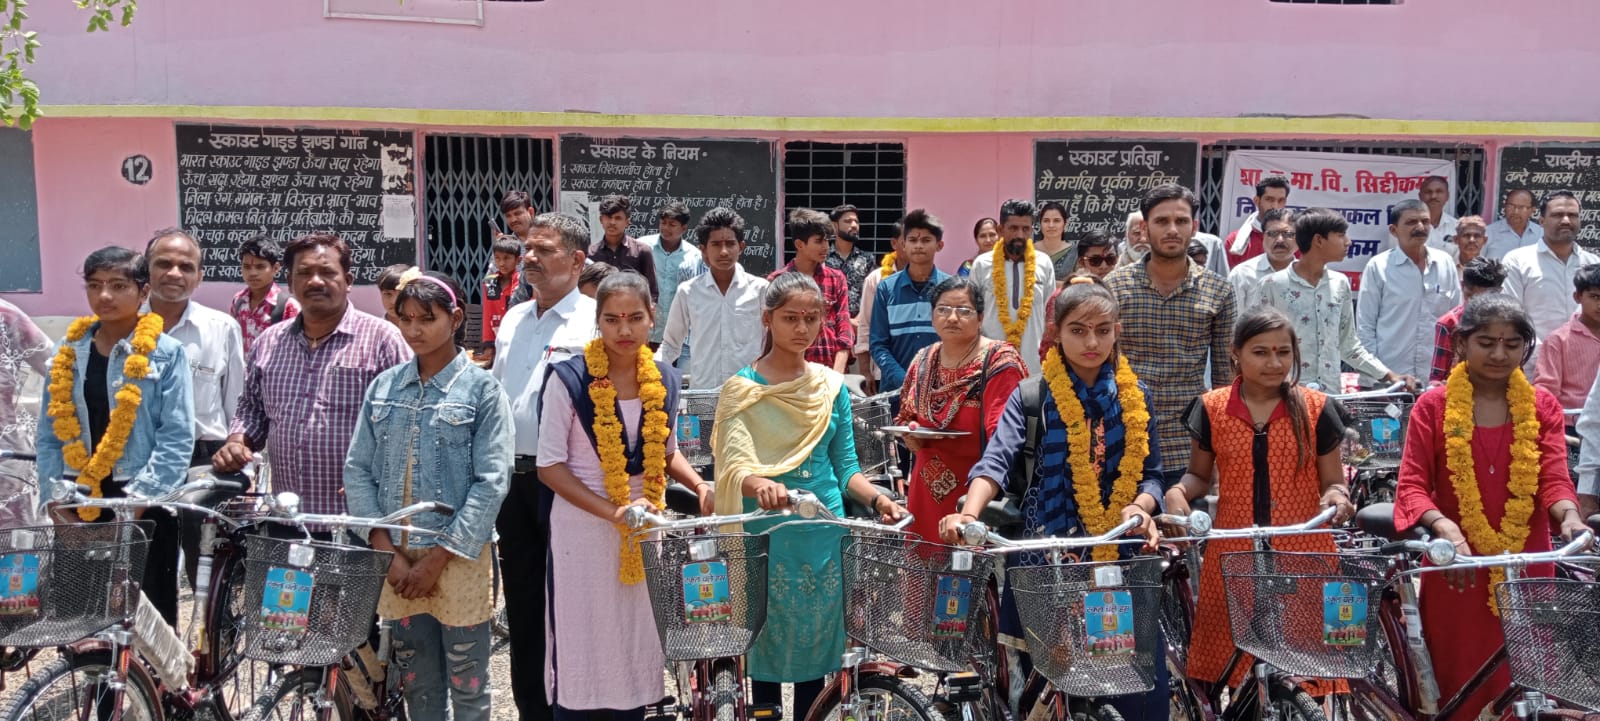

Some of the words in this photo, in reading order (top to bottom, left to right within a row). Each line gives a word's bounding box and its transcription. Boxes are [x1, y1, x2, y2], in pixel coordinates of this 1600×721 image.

[209, 133, 261, 149] स्काउट
[262, 134, 298, 153] गाइड
[301, 135, 337, 154] झण्डा
[340, 136, 369, 150] गान
[589, 144, 638, 161] स्काउट
[641, 141, 657, 160] के
[662, 142, 701, 161] नियम
[180, 153, 208, 168] भारत
[209, 154, 243, 169] स्काउट
[243, 155, 271, 172] गाइड
[329, 157, 351, 172] सदा
[1069, 150, 1118, 166] स्काउट
[1119, 145, 1163, 170] प्रतिज्ञा
[1544, 150, 1593, 170] राष्ट्रीय
[124, 157, 149, 181] 12
[570, 163, 597, 175] स्काउट
[642, 163, 662, 179] होता
[663, 163, 674, 179] है
[207, 172, 229, 189] सदा
[319, 175, 342, 190] सदा
[344, 172, 375, 192] रहेगा
[632, 178, 653, 194] होता
[655, 177, 666, 194] है
[1054, 169, 1098, 194] मर्यादा
[1099, 170, 1137, 194] पूर्वक
[735, 194, 754, 210] होता
[214, 211, 246, 225] कमल
[338, 208, 354, 225] की
[356, 213, 378, 229] याद
